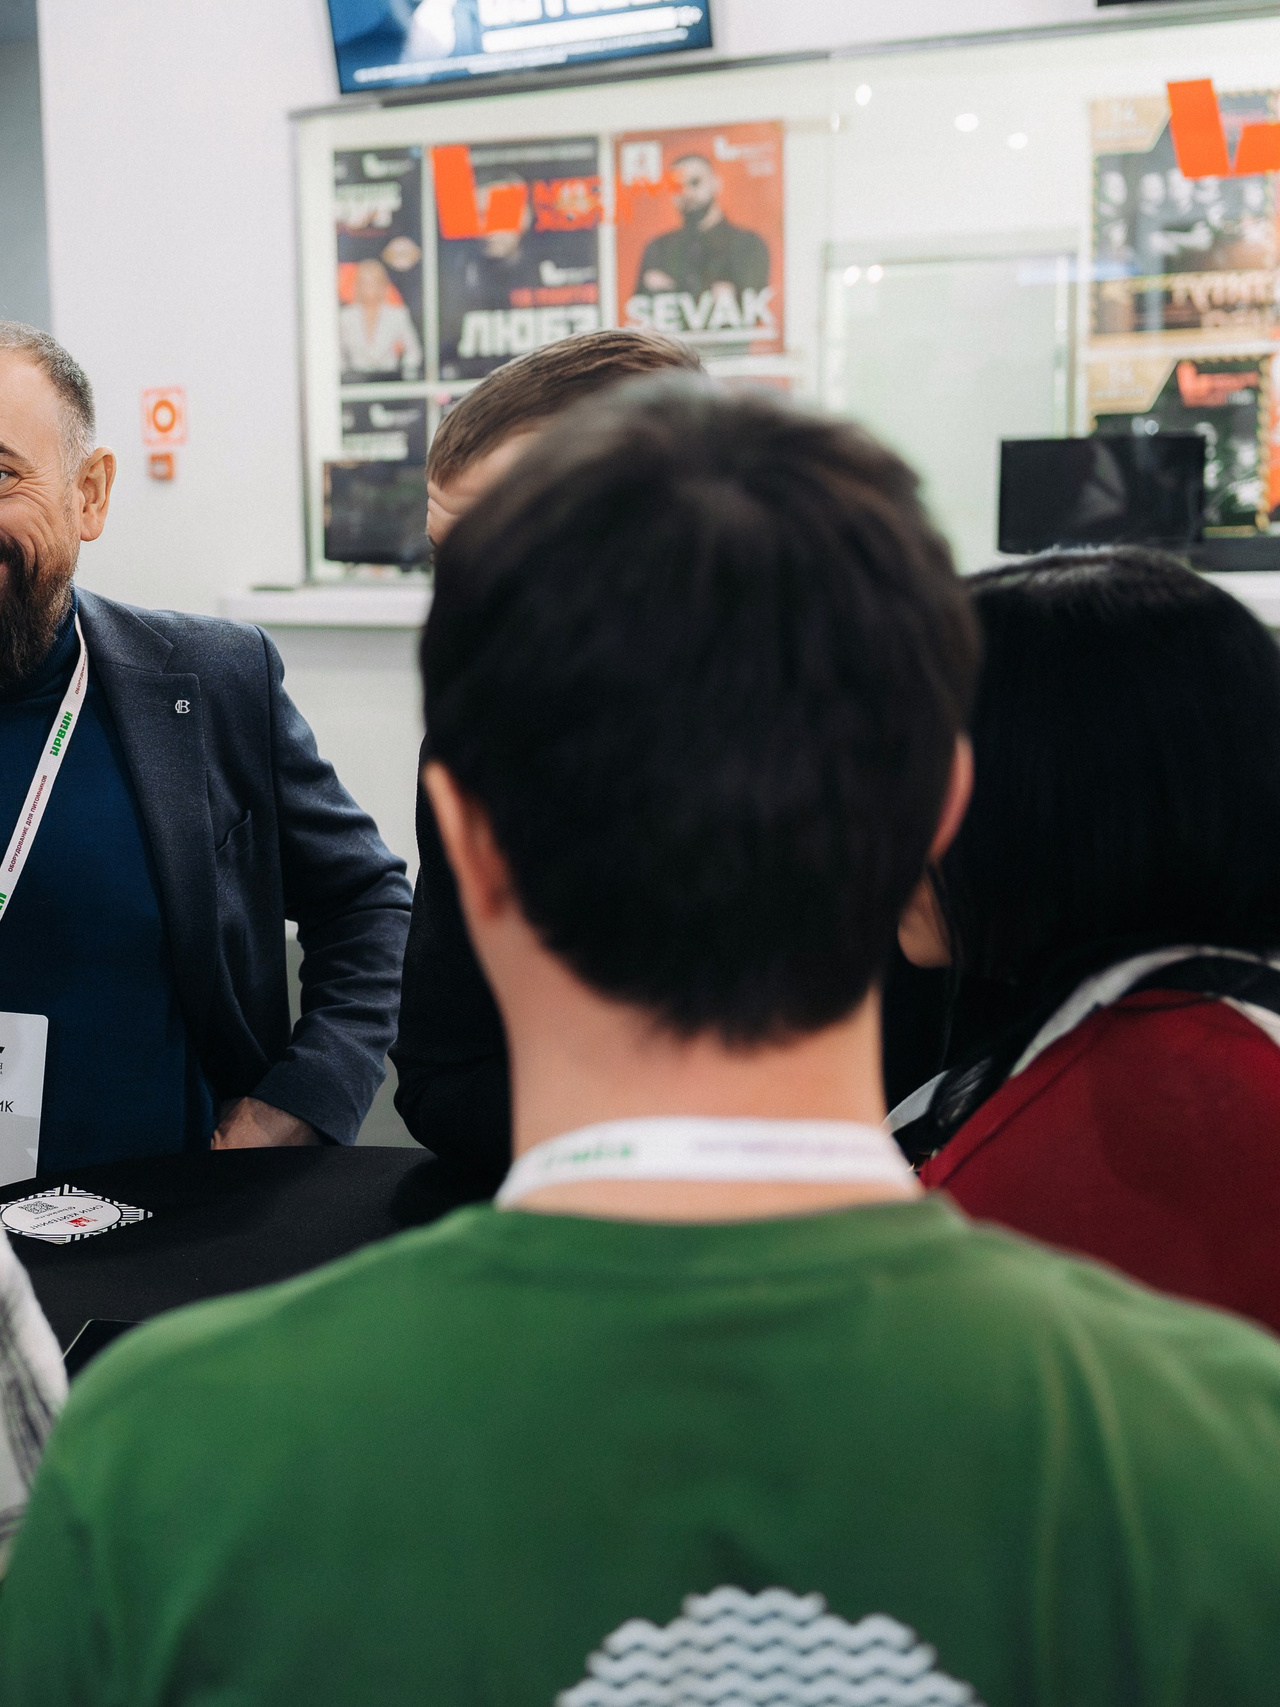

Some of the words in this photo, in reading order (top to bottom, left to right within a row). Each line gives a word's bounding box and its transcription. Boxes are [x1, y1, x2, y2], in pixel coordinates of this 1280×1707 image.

[625, 287, 776, 332] SEVAK
[8, 826, 29, 873] ОБОРУДОВАНИЕ
[25, 812, 34, 827] ДЛЯ
[30, 774, 48, 813] ПИТОМНИКОВ
